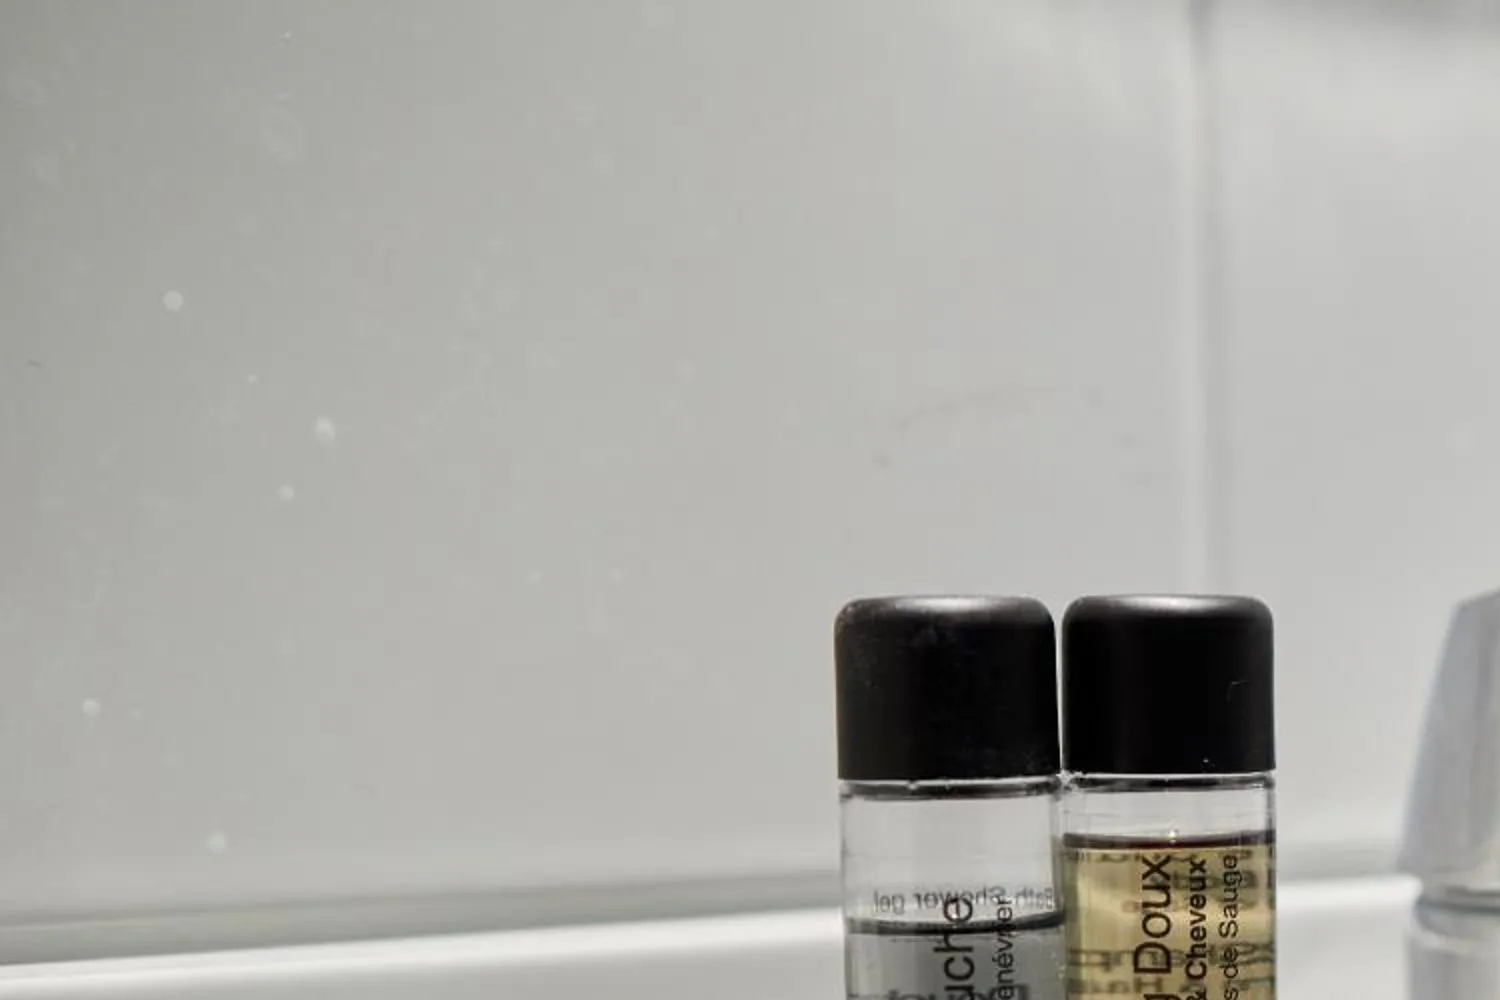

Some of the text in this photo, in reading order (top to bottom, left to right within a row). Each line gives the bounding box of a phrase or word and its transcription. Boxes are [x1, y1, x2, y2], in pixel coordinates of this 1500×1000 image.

[1132, 853, 1174, 975] Doux
[1186, 858, 1208, 982] Cheveux
[1218, 853, 1243, 939] Sauge
[1218, 946, 1240, 980] de
